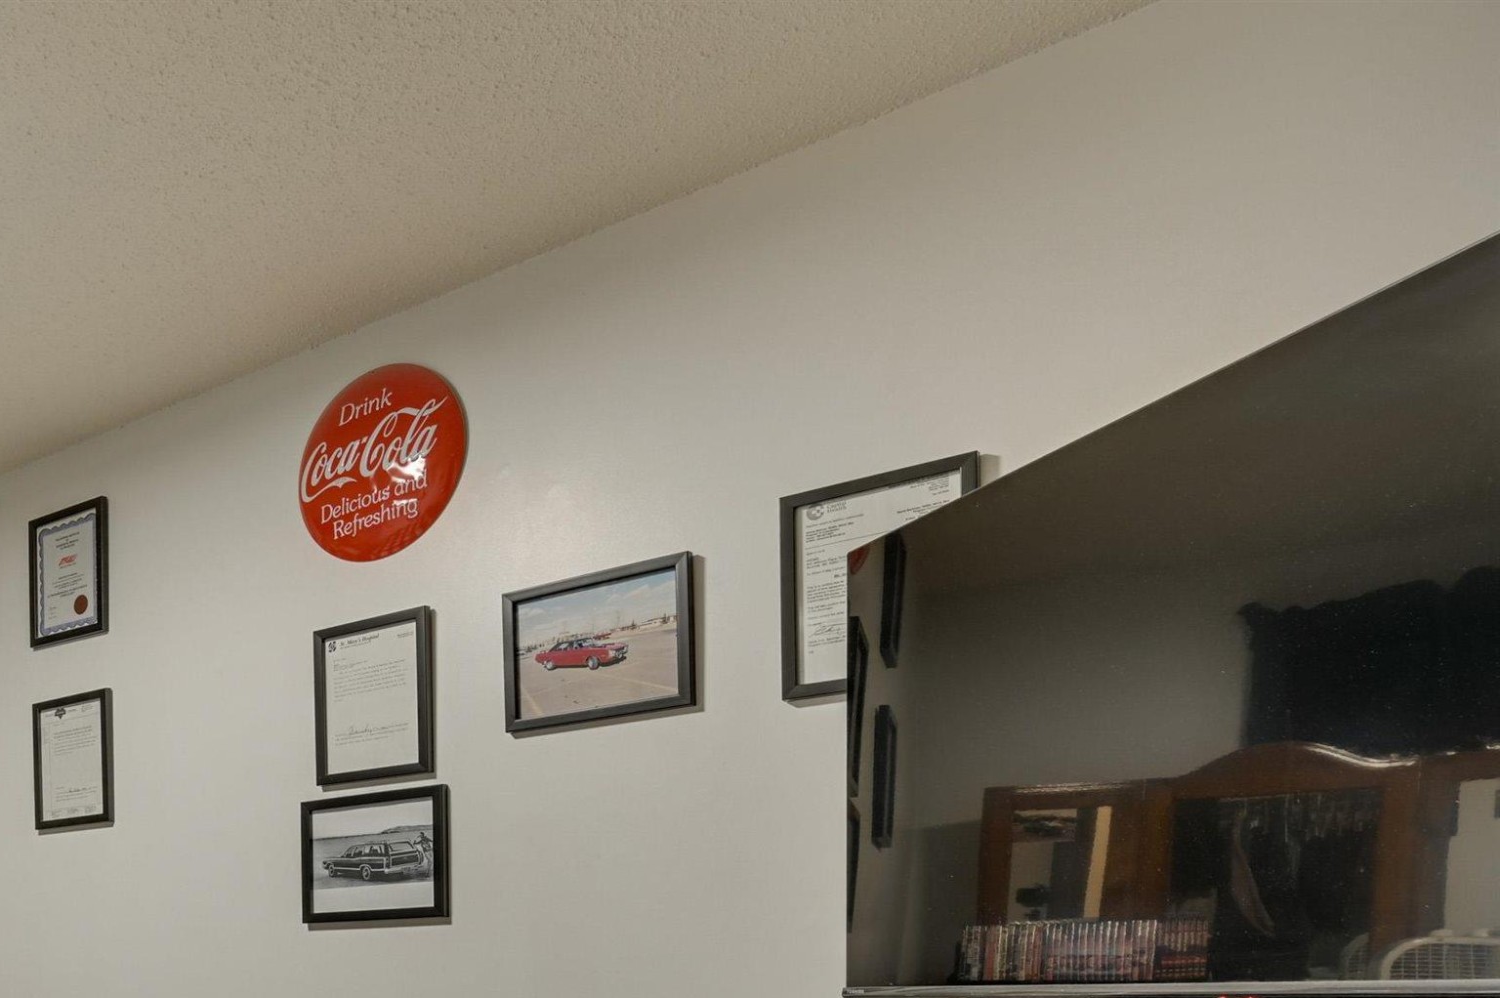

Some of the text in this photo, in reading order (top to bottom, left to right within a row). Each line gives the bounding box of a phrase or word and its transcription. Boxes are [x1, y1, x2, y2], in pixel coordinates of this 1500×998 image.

[338, 387, 393, 428] Drink
[301, 395, 448, 504] Coca-Cola
[320, 467, 428, 525] Delicious and
[332, 497, 419, 541] Refreshing
